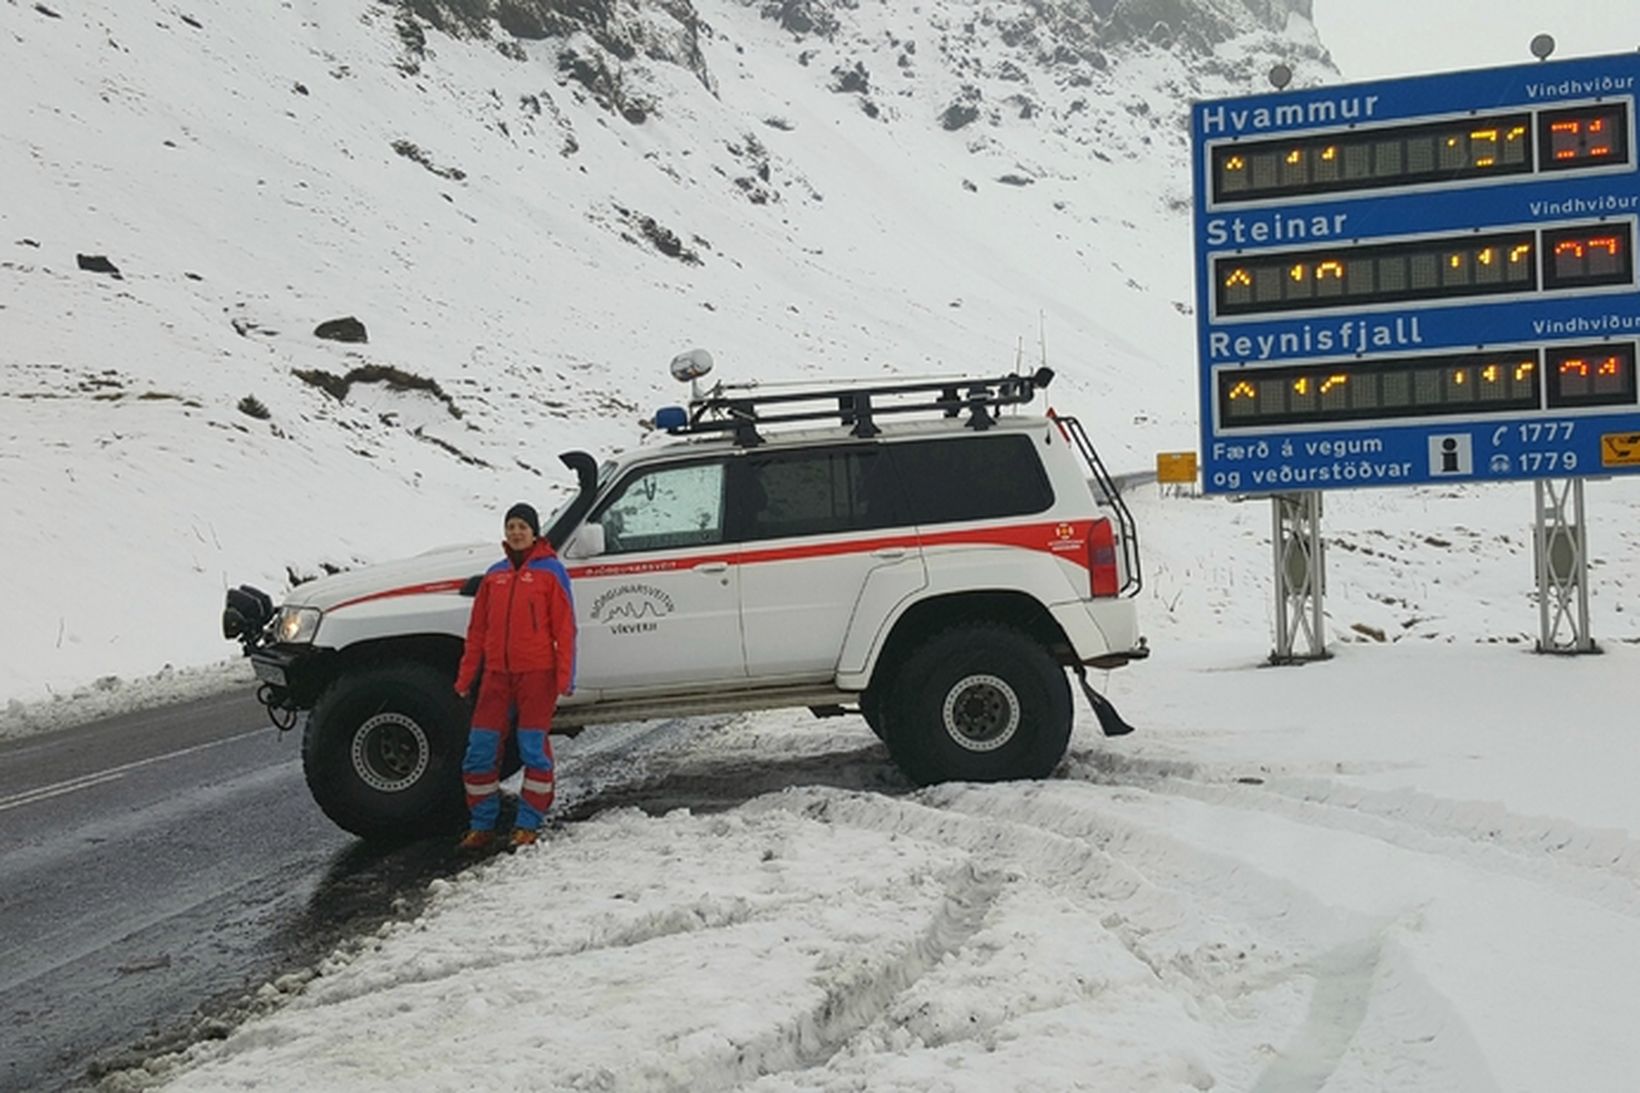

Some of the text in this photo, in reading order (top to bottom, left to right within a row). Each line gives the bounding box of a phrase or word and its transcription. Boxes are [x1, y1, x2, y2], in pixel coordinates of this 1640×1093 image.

[1526, 76, 1634, 98] Vindhviður
[1203, 96, 1378, 133] Hvammur
[1530, 195, 1639, 216] Vindhviður
[1207, 213, 1347, 245] Steinar
[1210, 316, 1422, 359] Reynisfjall
[1519, 422, 1574, 443] 1777
[1213, 438, 1382, 460] Færð á vegum
[1519, 452, 1577, 472] 1779
[1213, 461, 1412, 488] og veðurstöðvar
